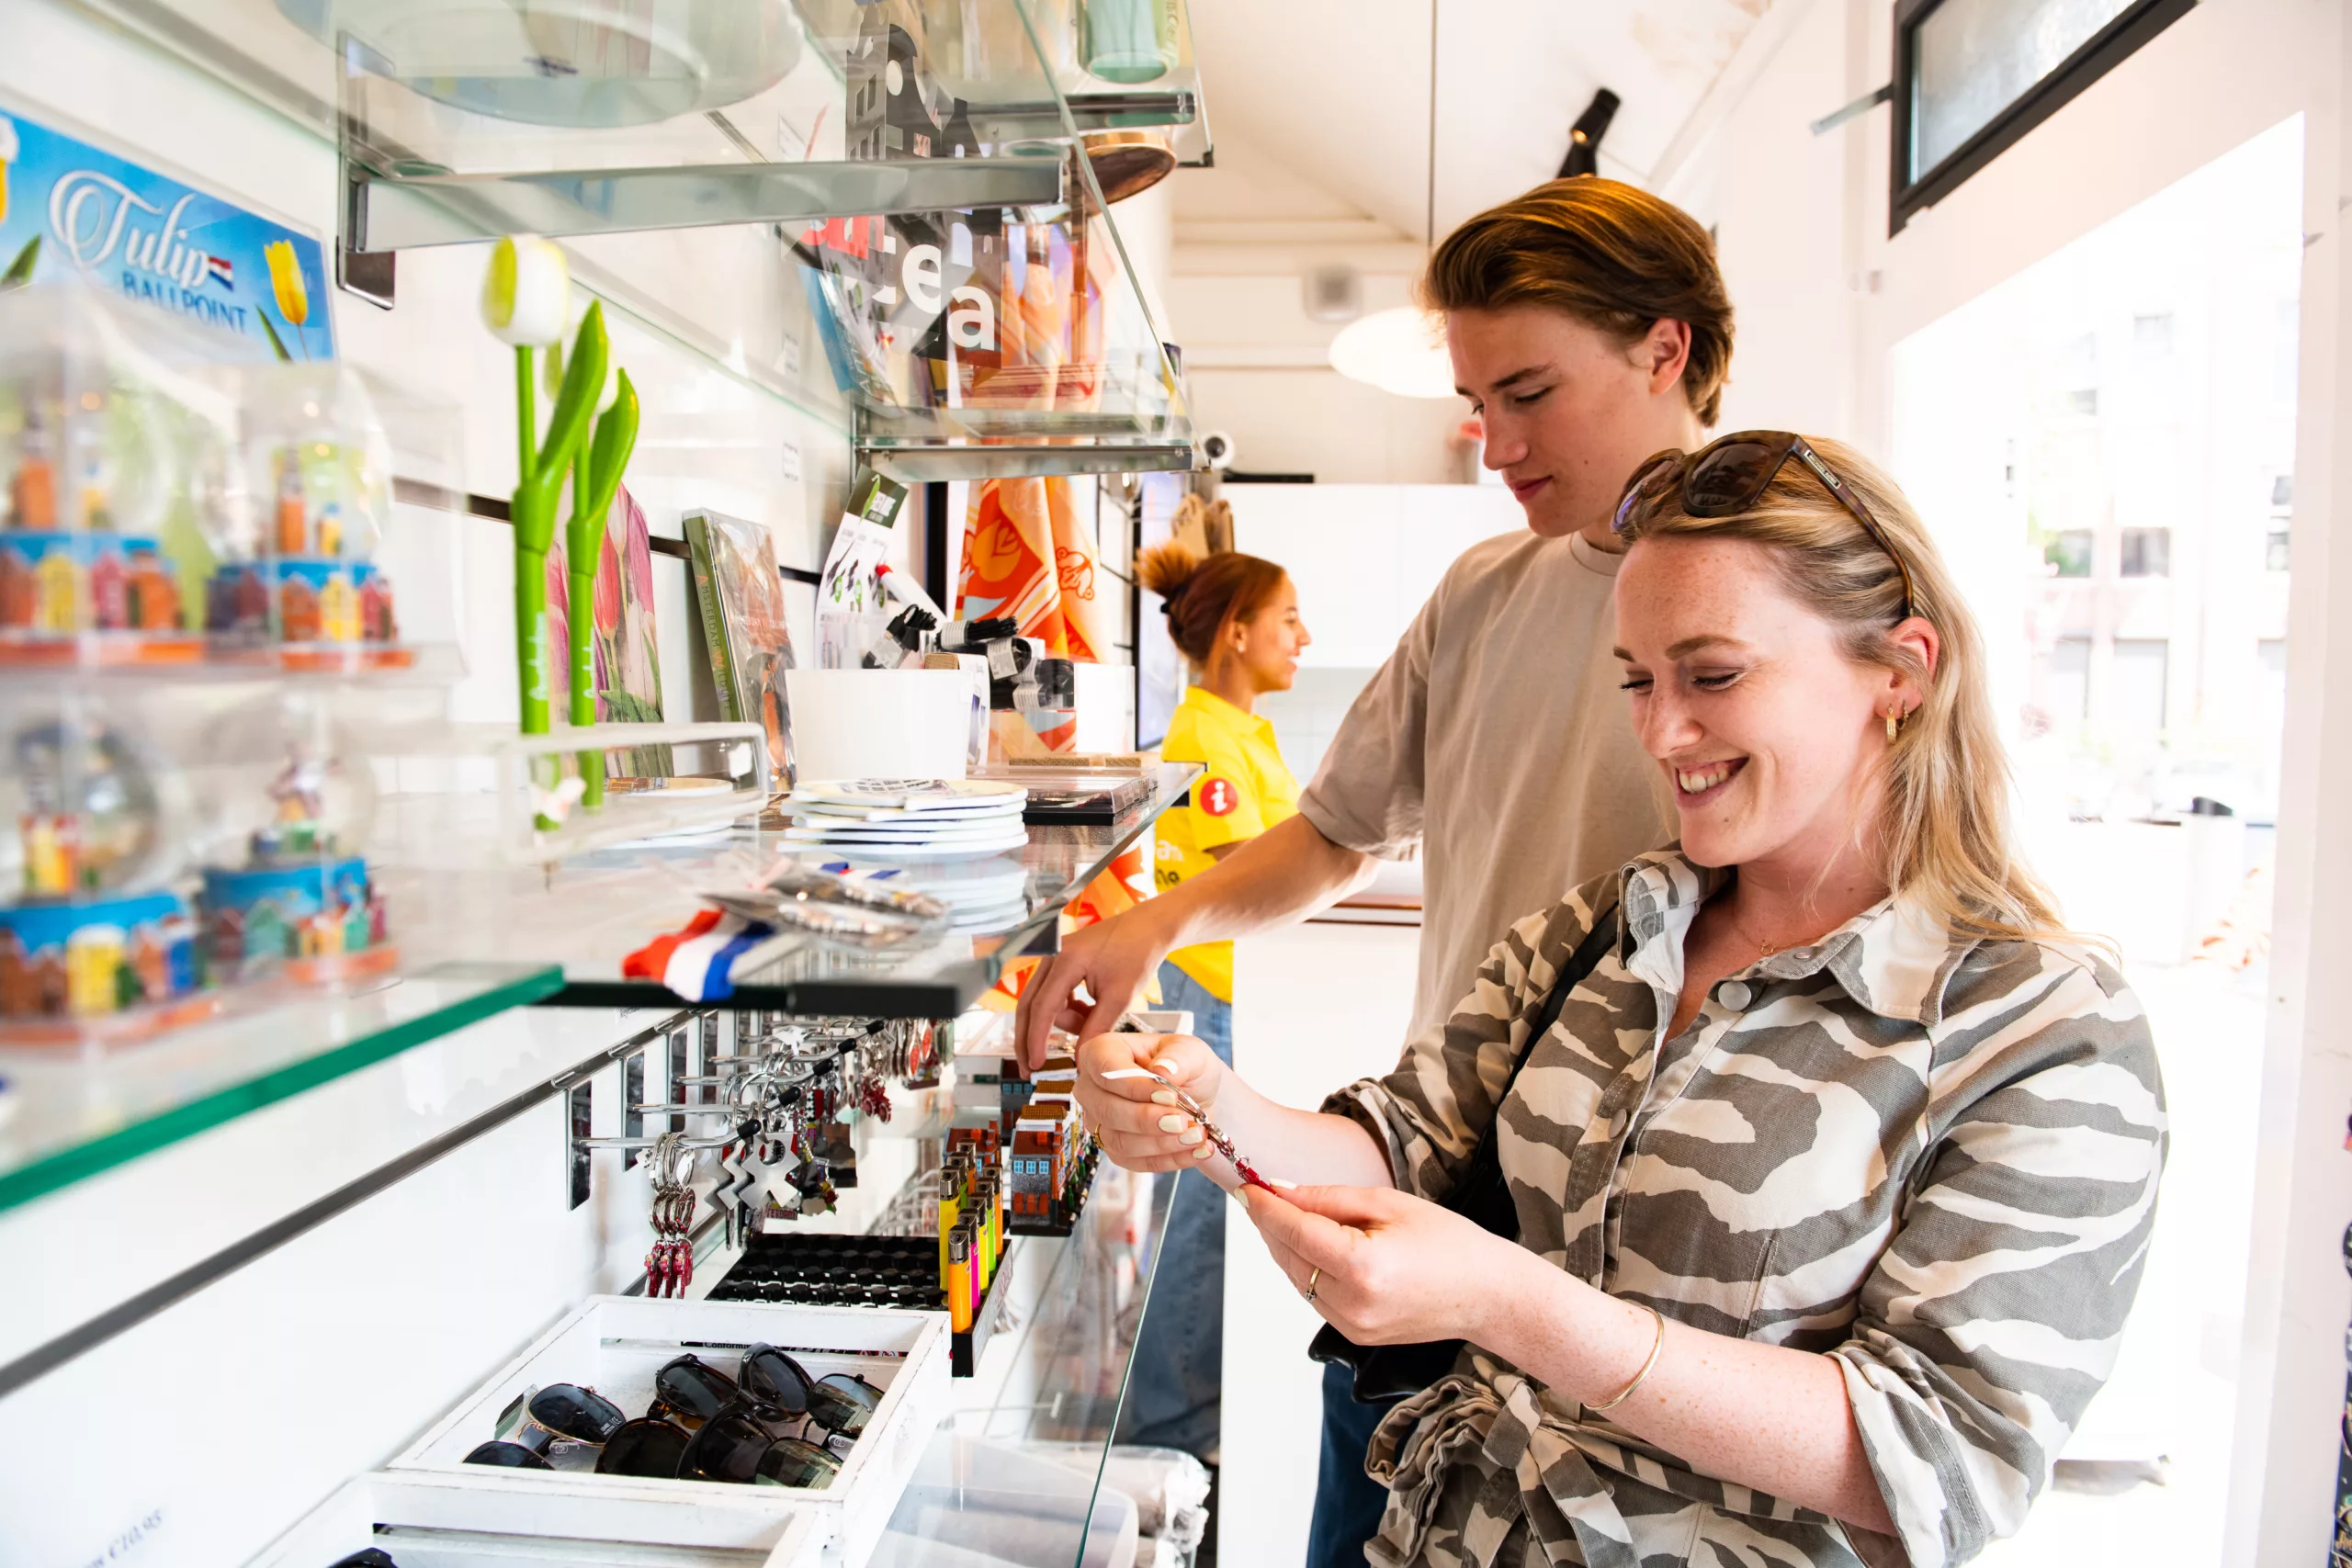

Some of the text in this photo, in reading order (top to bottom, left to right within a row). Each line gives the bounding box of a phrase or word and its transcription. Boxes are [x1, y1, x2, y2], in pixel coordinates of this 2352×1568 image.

[49, 169, 209, 290] Tulip
[695, 573, 733, 712] AMSTERDAM WILDLIFE
